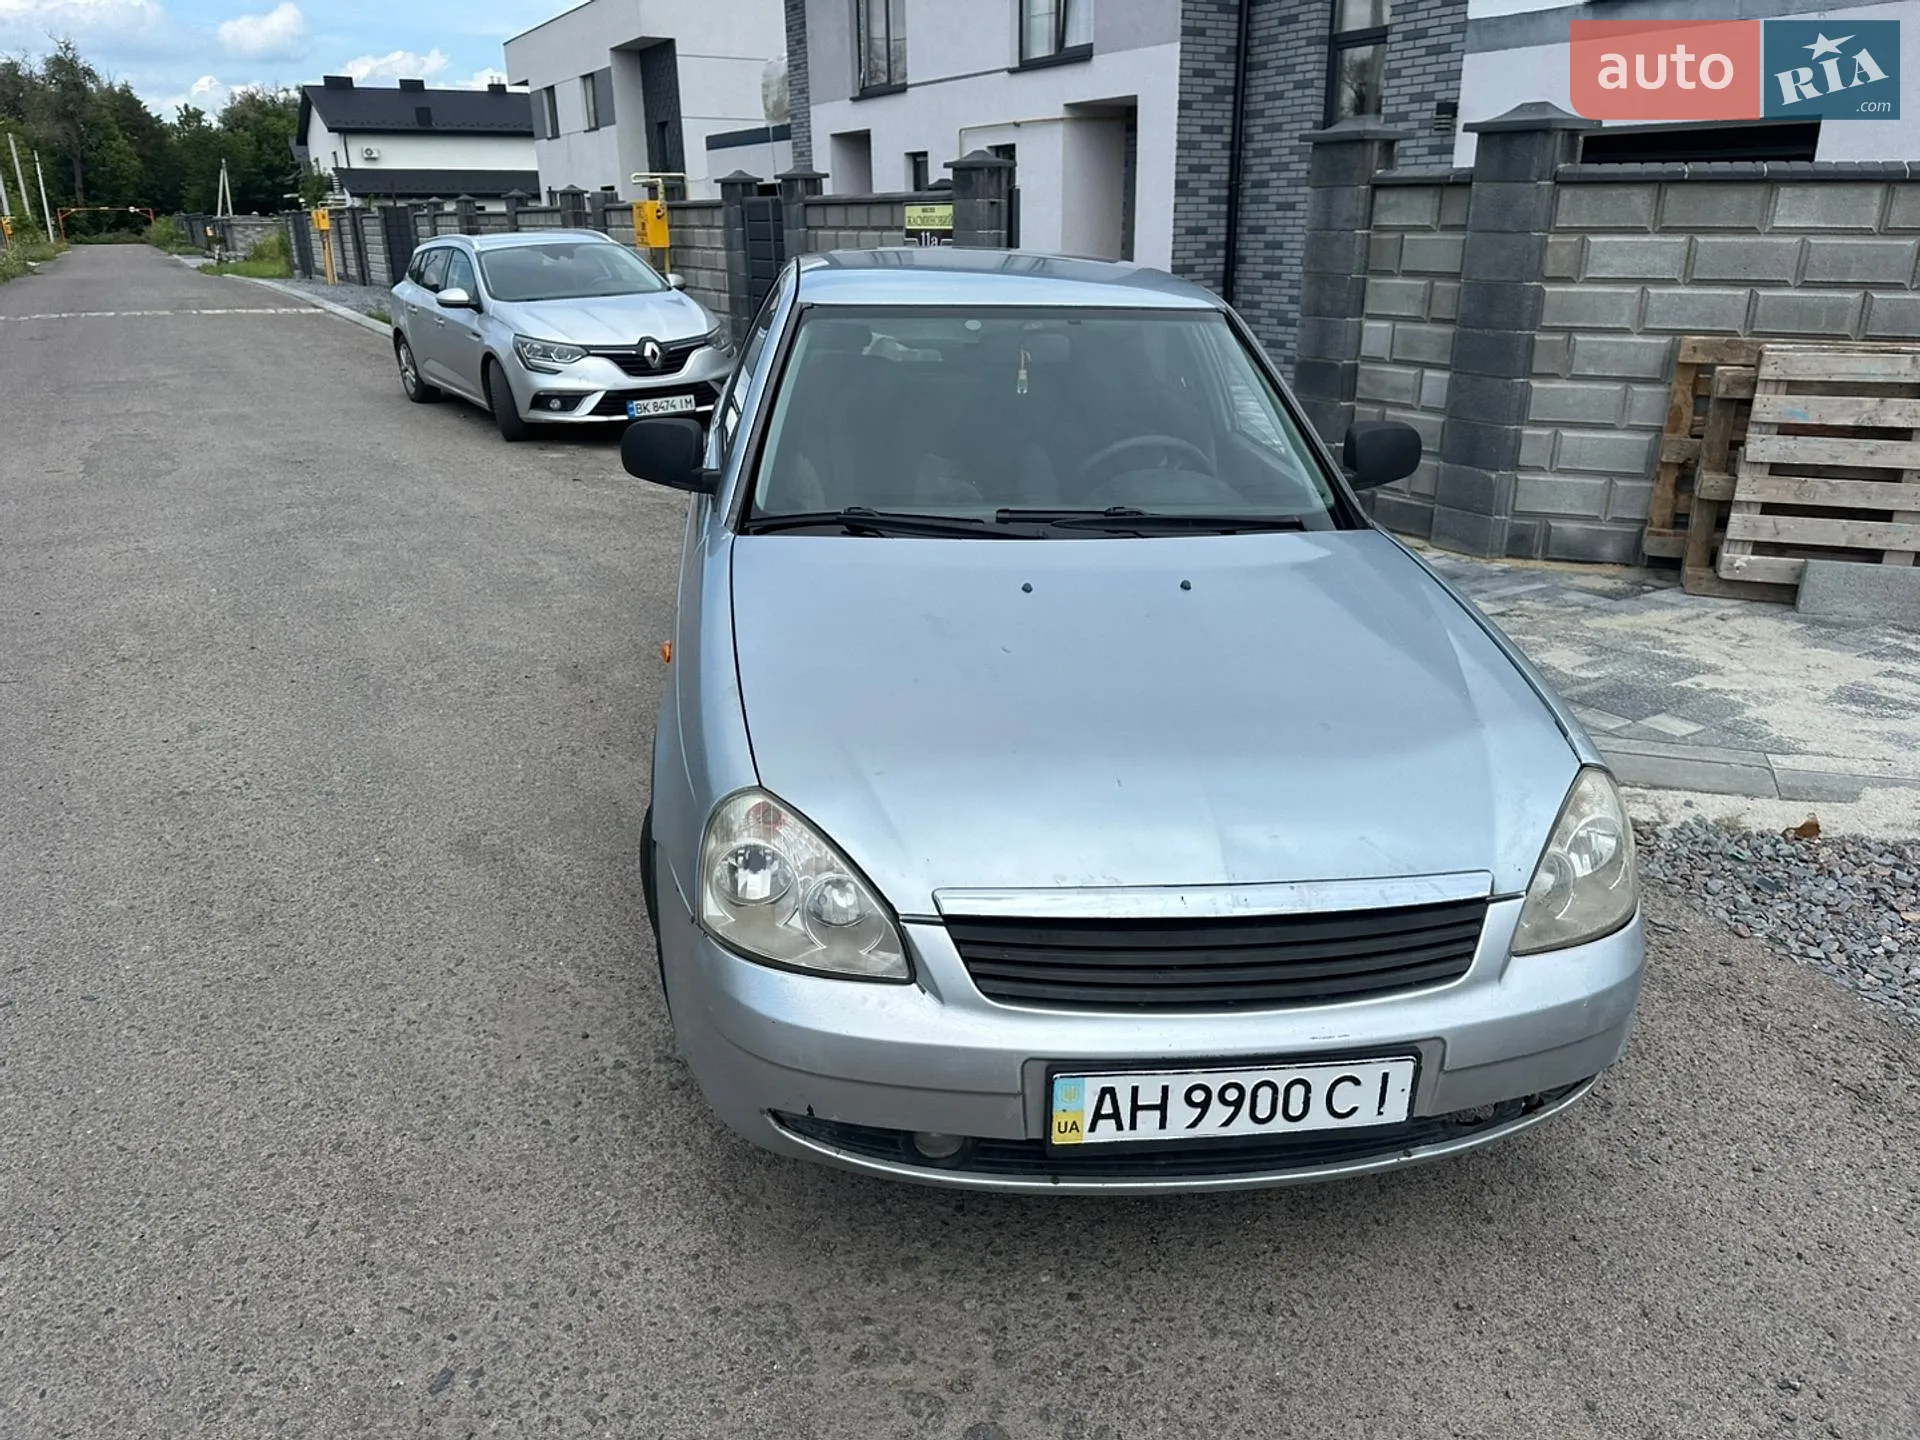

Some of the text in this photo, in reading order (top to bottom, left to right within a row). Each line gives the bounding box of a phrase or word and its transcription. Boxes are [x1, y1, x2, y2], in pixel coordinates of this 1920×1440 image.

[636, 402, 651, 415] BK
[652, 399, 676, 412] 8474
[1088, 1085, 1170, 1133] AH
[1184, 1077, 1313, 1129] 9900
[1057, 1119, 1080, 1134] UA
